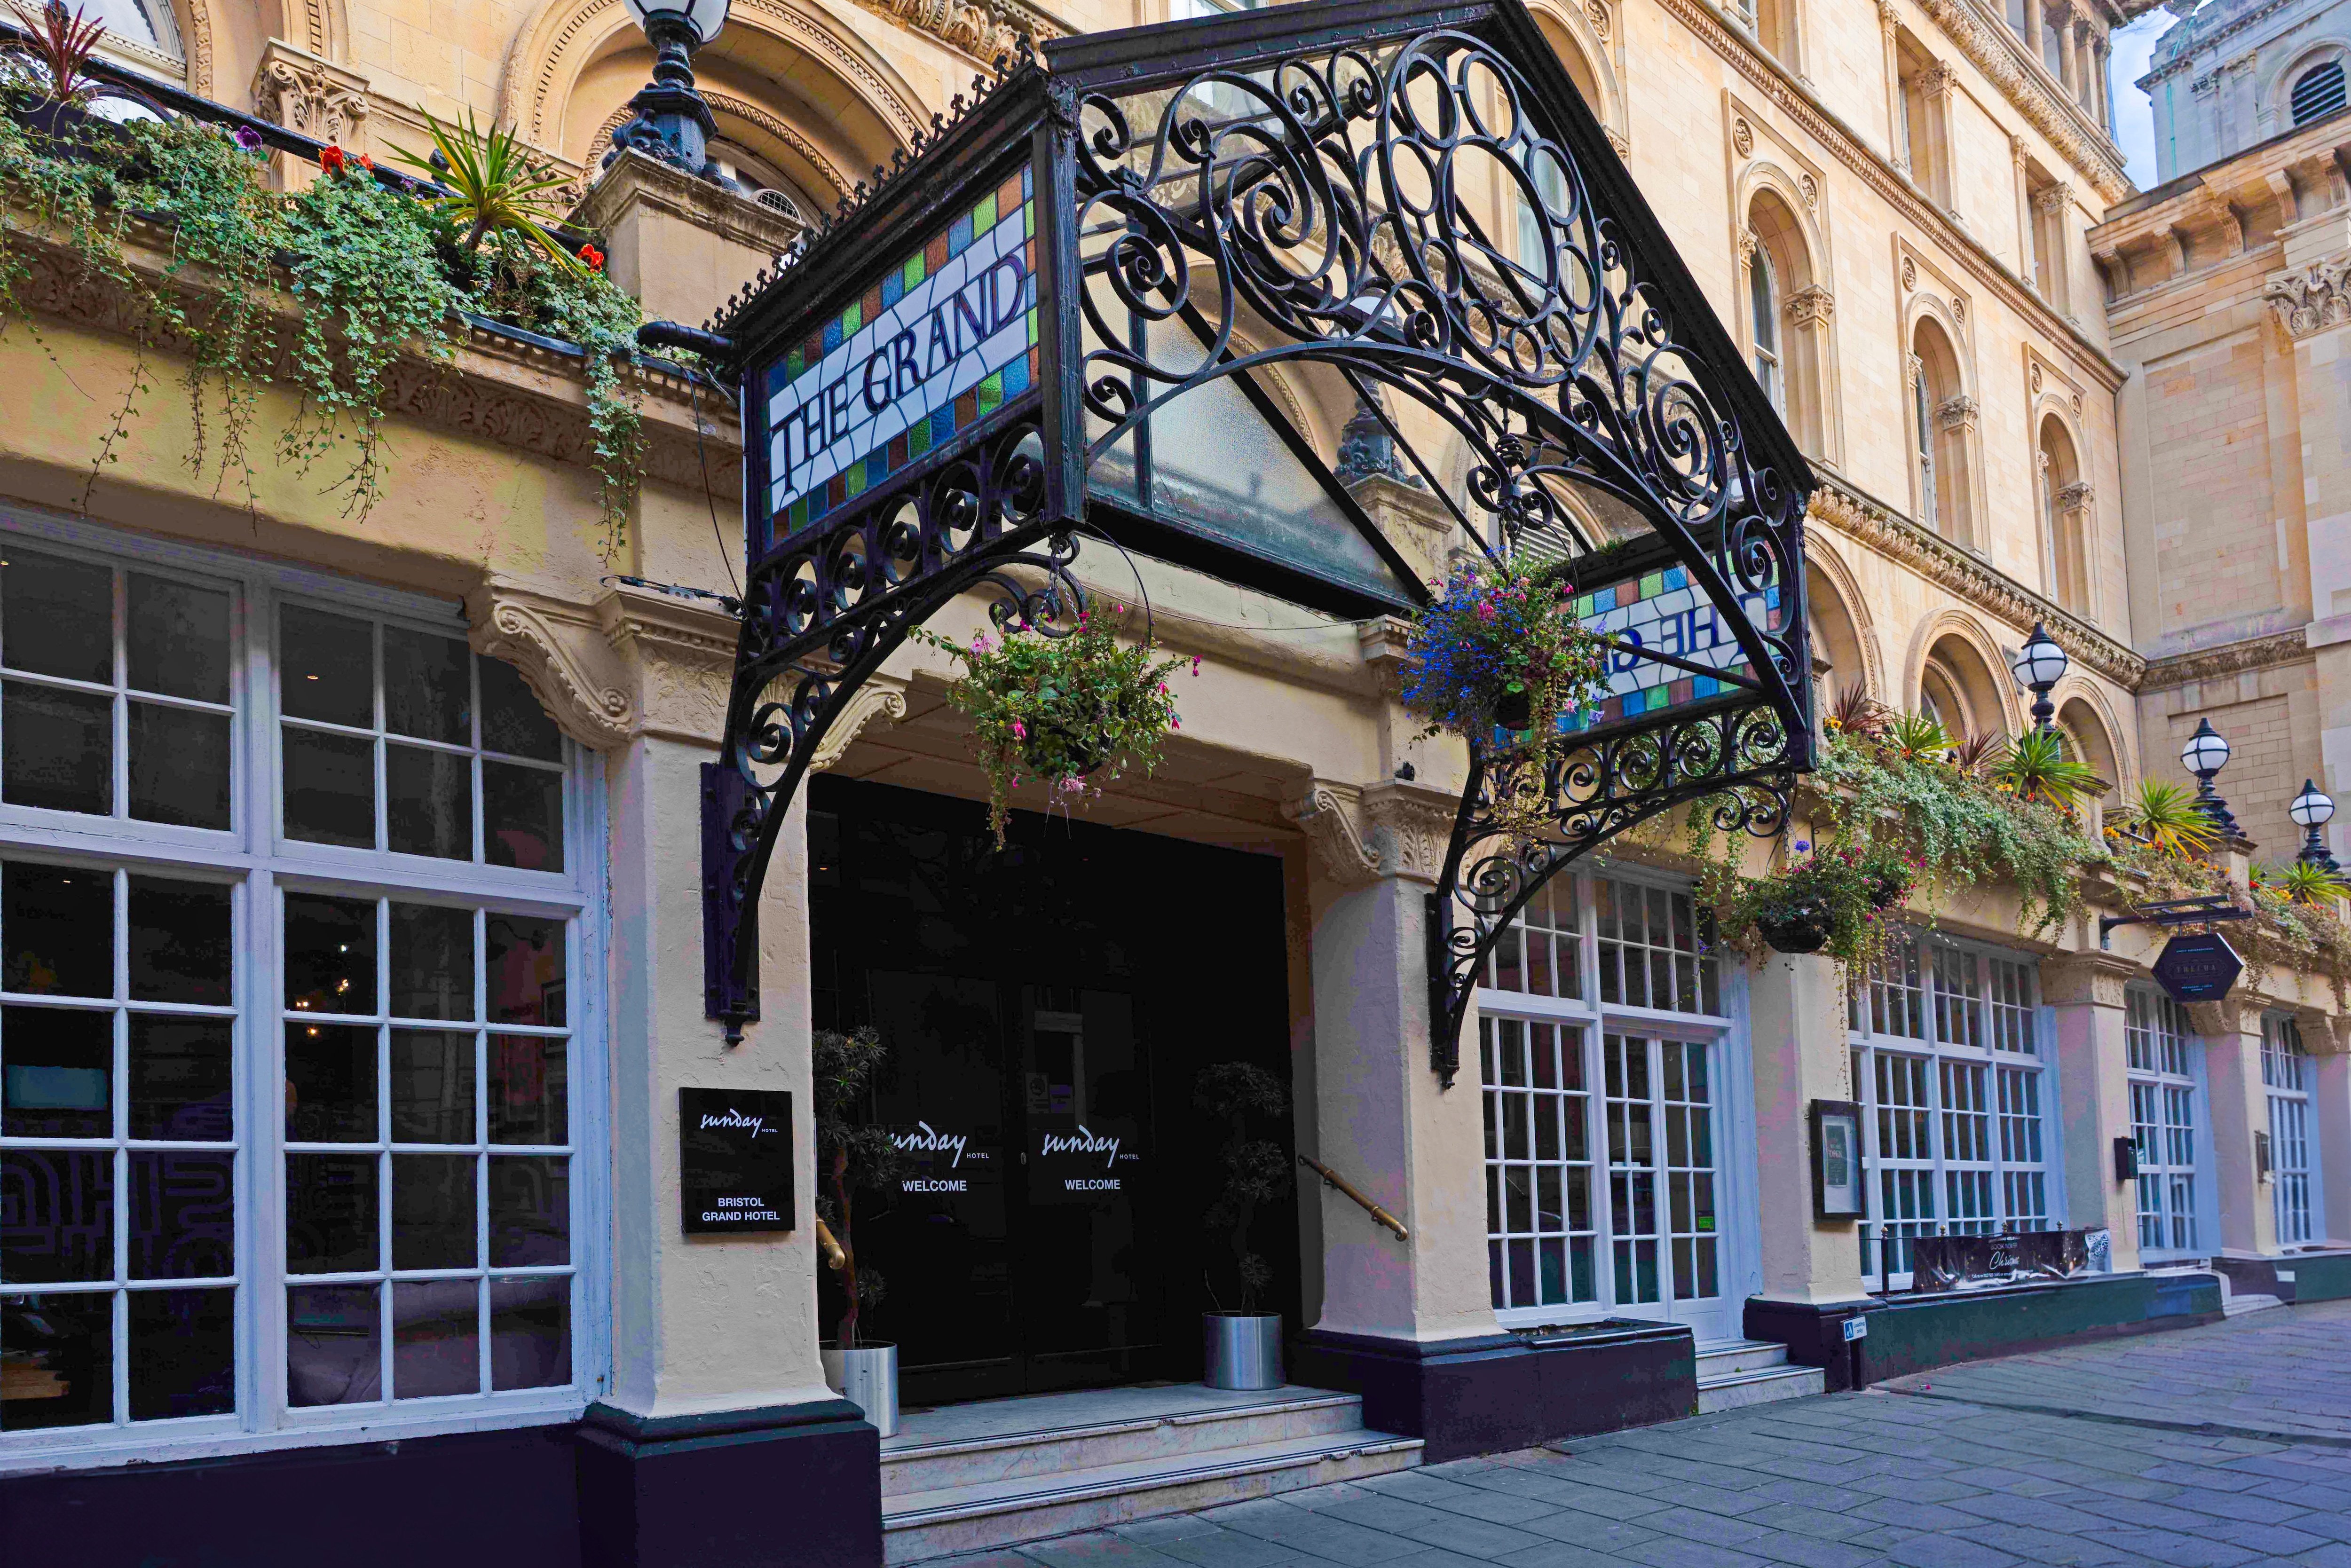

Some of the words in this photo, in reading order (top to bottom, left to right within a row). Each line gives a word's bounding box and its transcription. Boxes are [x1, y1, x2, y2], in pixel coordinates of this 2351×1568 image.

[771, 376, 847, 492] THE
[863, 253, 1026, 415] GRAND
[700, 1108, 763, 1138] sunday
[890, 1120, 967, 1168] unday
[1042, 1124, 1120, 1168] sunday
[902, 1180, 967, 1191] WELCOME
[1065, 1179, 1120, 1190] WELCOME
[718, 1198, 765, 1207] BRISTOL
[702, 1212, 742, 1221] GRAND
[745, 1211, 780, 1221] HOTEL
